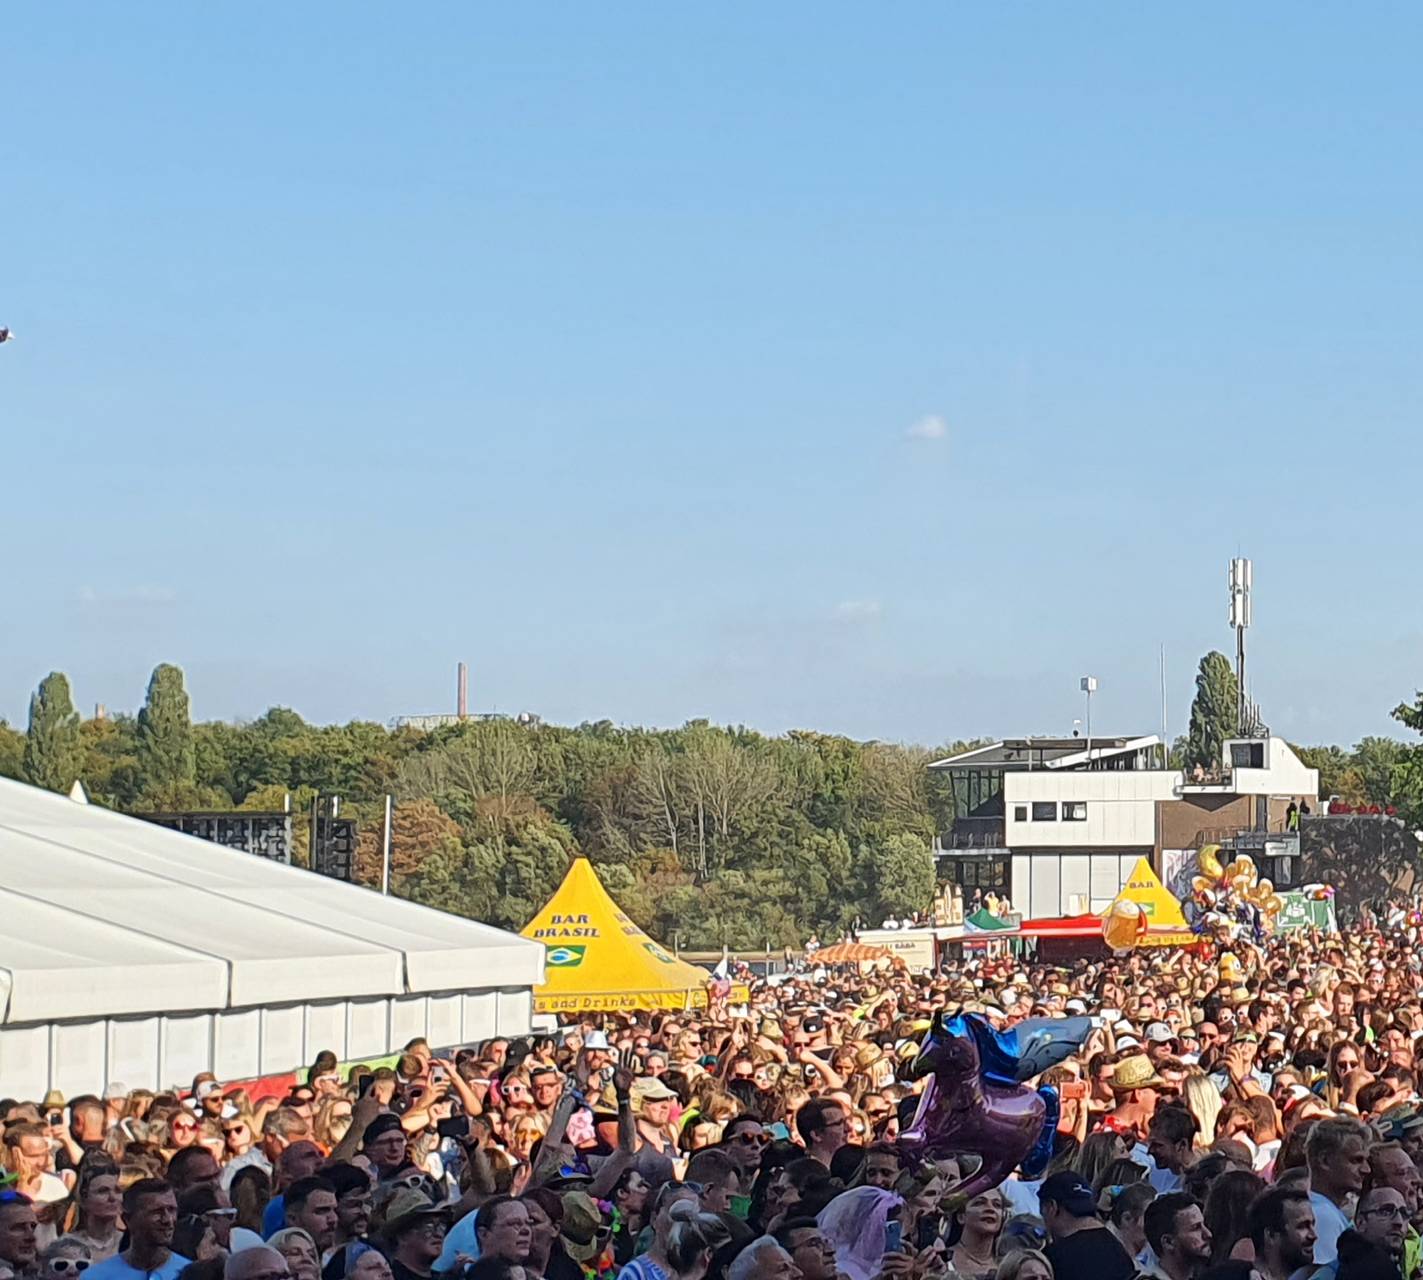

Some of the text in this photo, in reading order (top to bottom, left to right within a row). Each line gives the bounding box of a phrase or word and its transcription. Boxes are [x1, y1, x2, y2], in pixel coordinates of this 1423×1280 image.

[551, 914, 589, 924] BAR
[533, 927, 601, 938] BRASIL
[551, 998, 577, 1008] and
[582, 996, 636, 1008] Drinks
